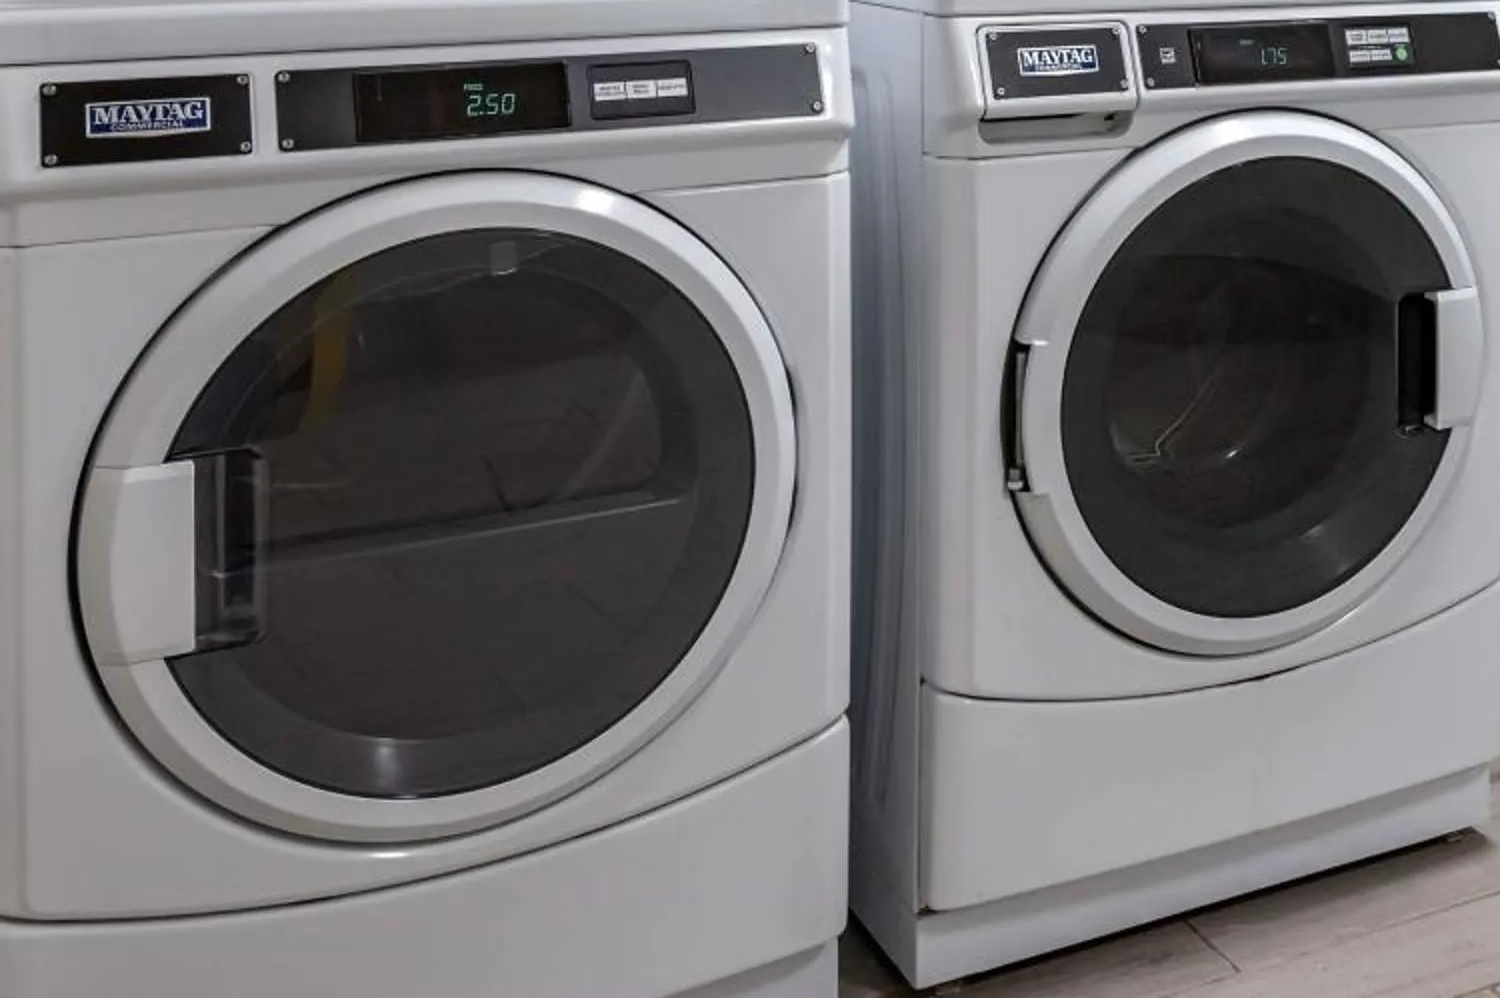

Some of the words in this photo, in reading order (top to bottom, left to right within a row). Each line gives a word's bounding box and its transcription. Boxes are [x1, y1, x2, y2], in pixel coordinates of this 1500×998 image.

[1022, 48, 1093, 67] MAYTAG
[92, 101, 203, 125] MAYTAG
[466, 92, 516, 117] 2.50
